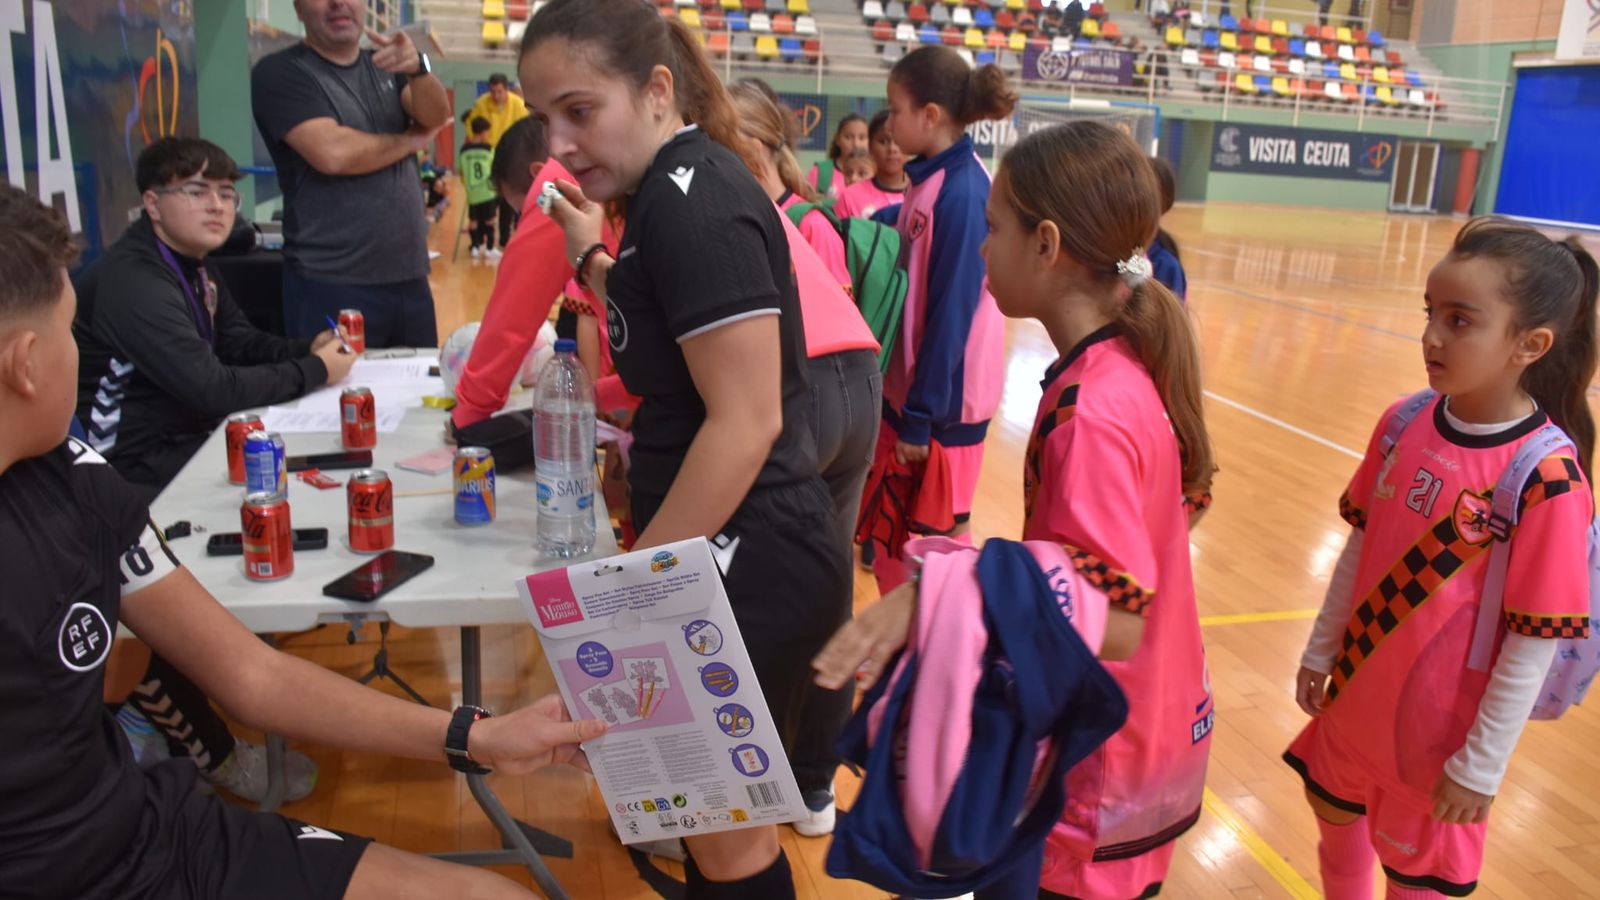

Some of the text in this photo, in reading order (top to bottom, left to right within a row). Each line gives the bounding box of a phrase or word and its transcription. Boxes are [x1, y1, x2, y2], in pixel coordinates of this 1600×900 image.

[1249, 136, 1296, 164] VISITA
[1303, 140, 1350, 168] CEUTA
[473, 162, 483, 180] 8
[1406, 467, 1443, 518] 21
